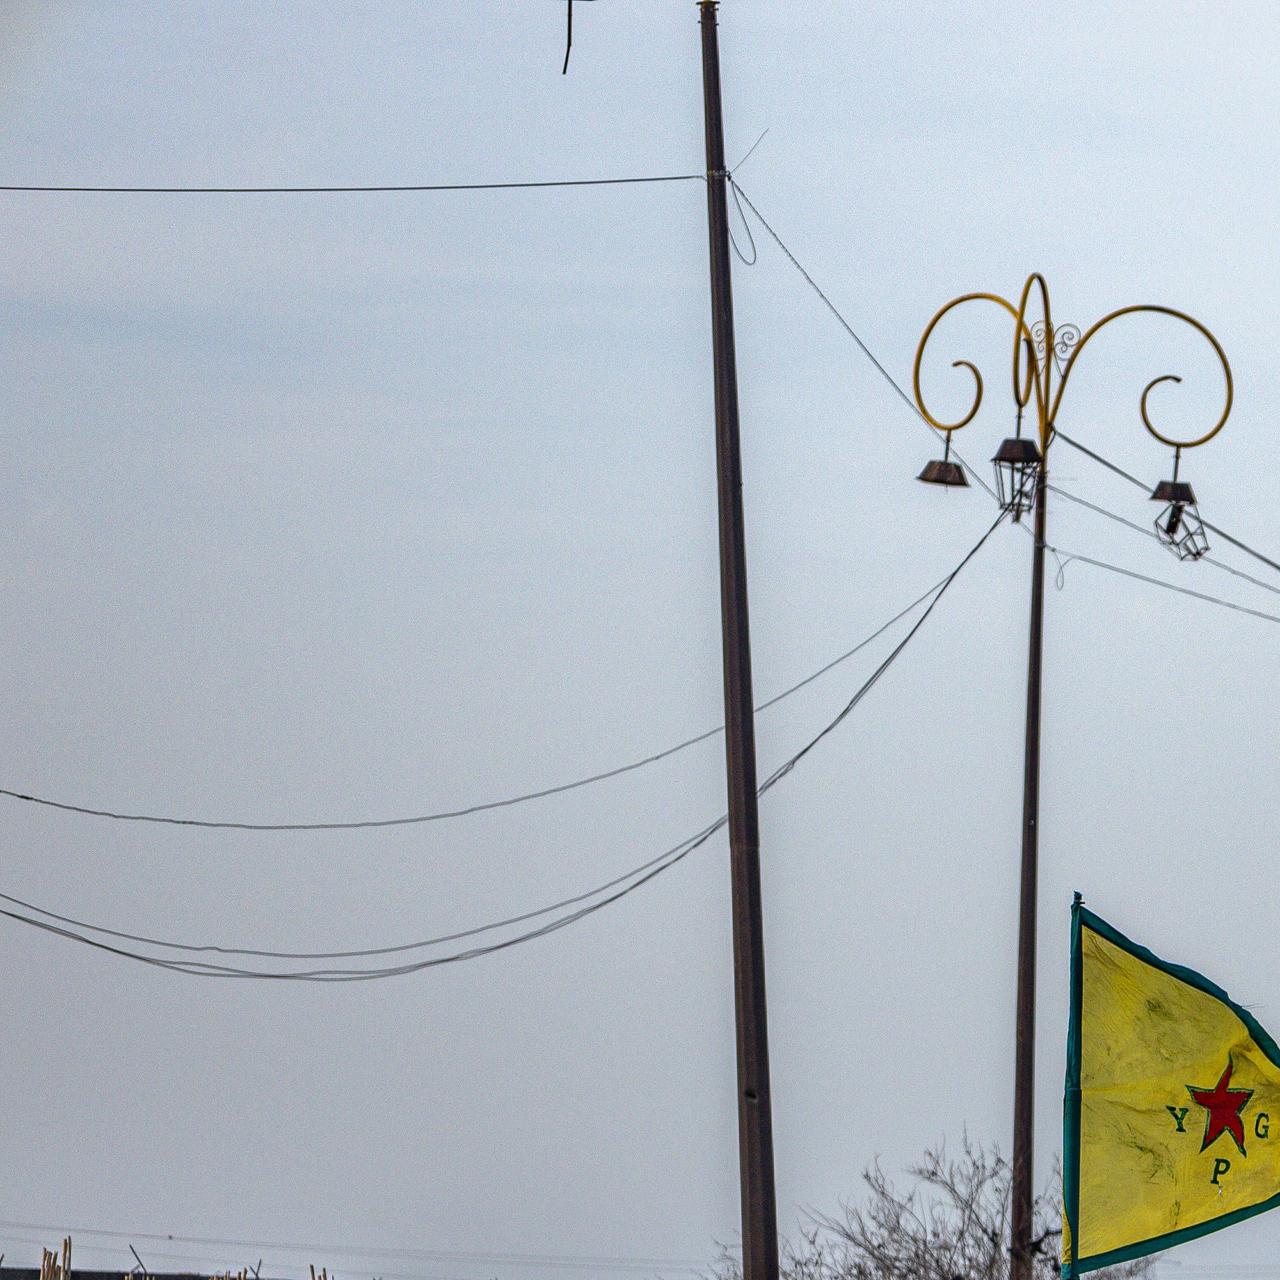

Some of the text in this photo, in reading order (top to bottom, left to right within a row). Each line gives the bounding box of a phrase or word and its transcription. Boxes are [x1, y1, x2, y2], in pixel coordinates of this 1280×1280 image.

[1166, 1105, 1189, 1132] Y
[1254, 1112, 1270, 1139] G
[1210, 1157, 1231, 1185] P
